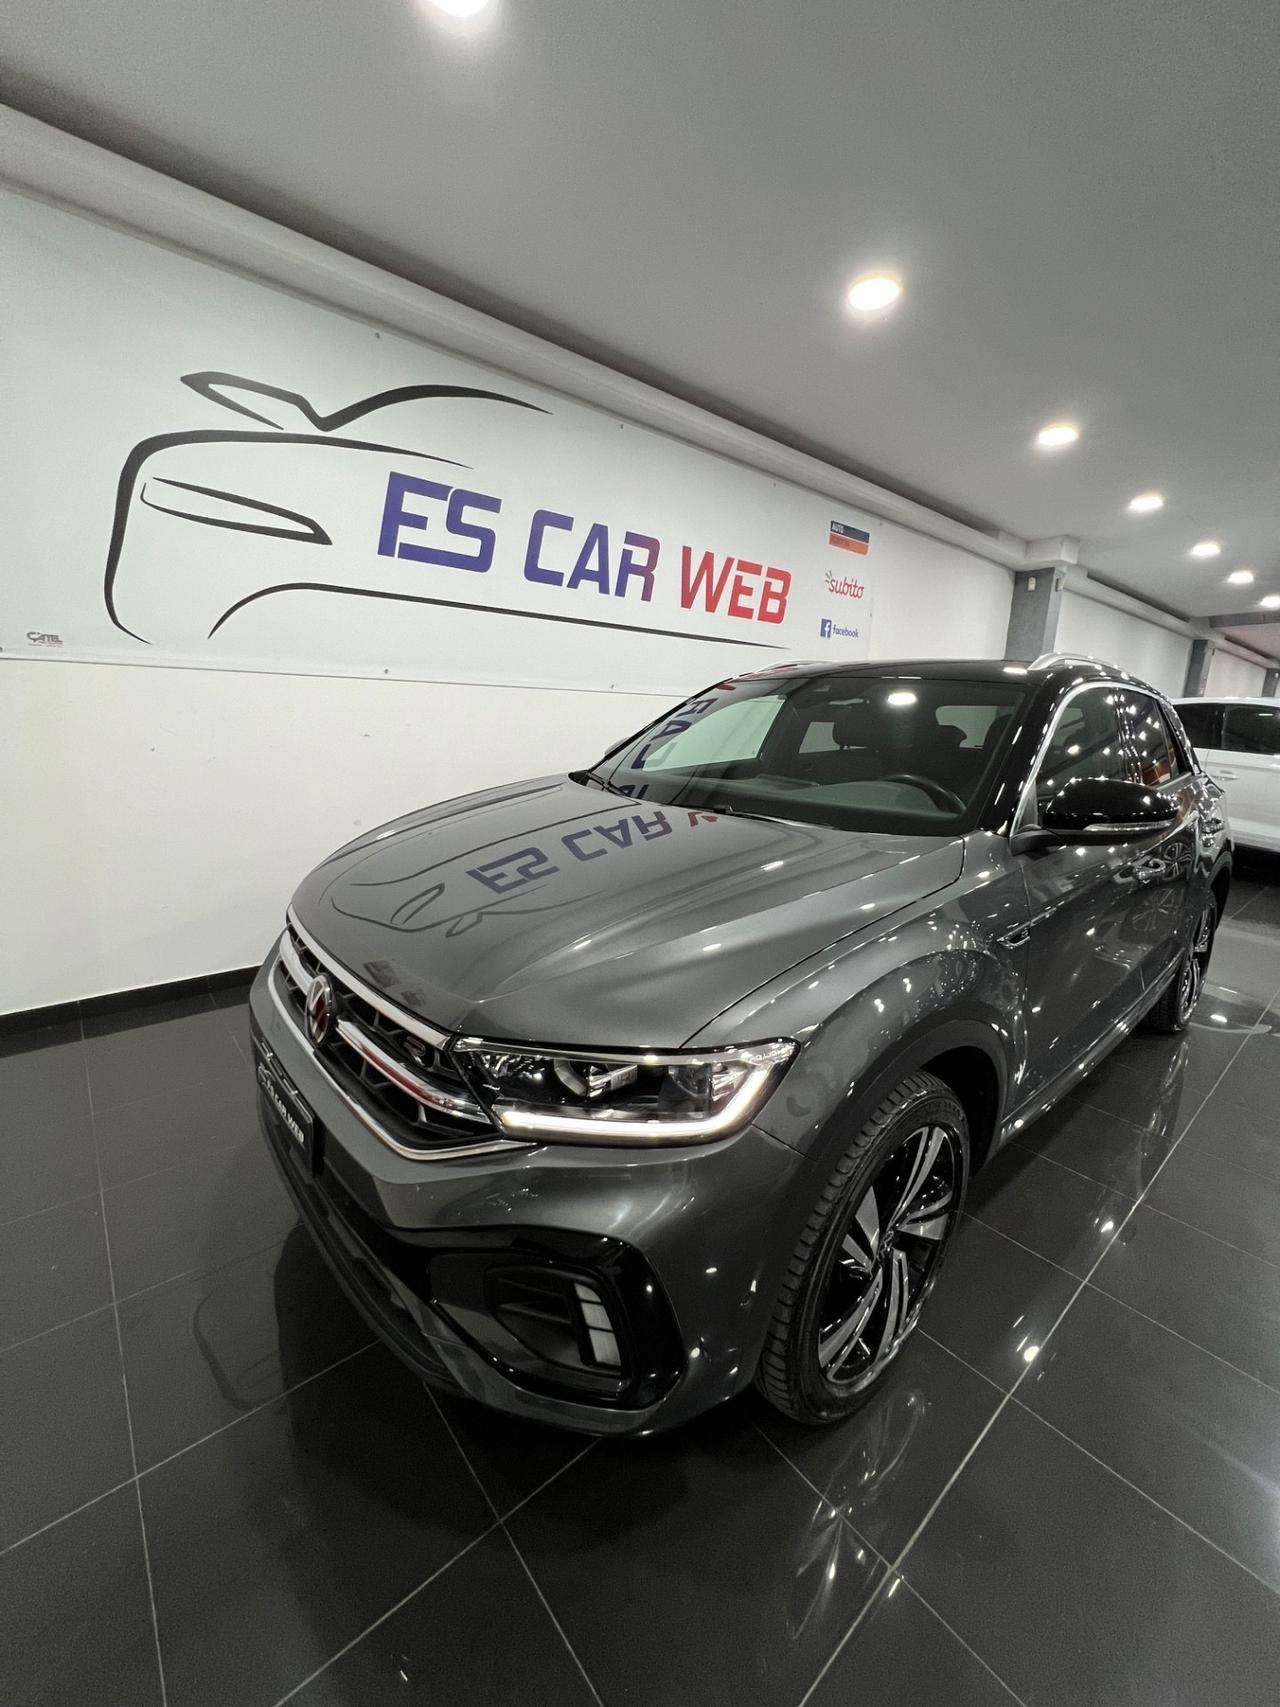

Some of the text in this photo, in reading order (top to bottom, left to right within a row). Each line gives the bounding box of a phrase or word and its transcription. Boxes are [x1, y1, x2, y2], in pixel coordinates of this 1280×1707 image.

[378, 471, 792, 625] ES CAR WEB
[828, 576, 864, 599] subito
[833, 624, 859, 638] facebook
